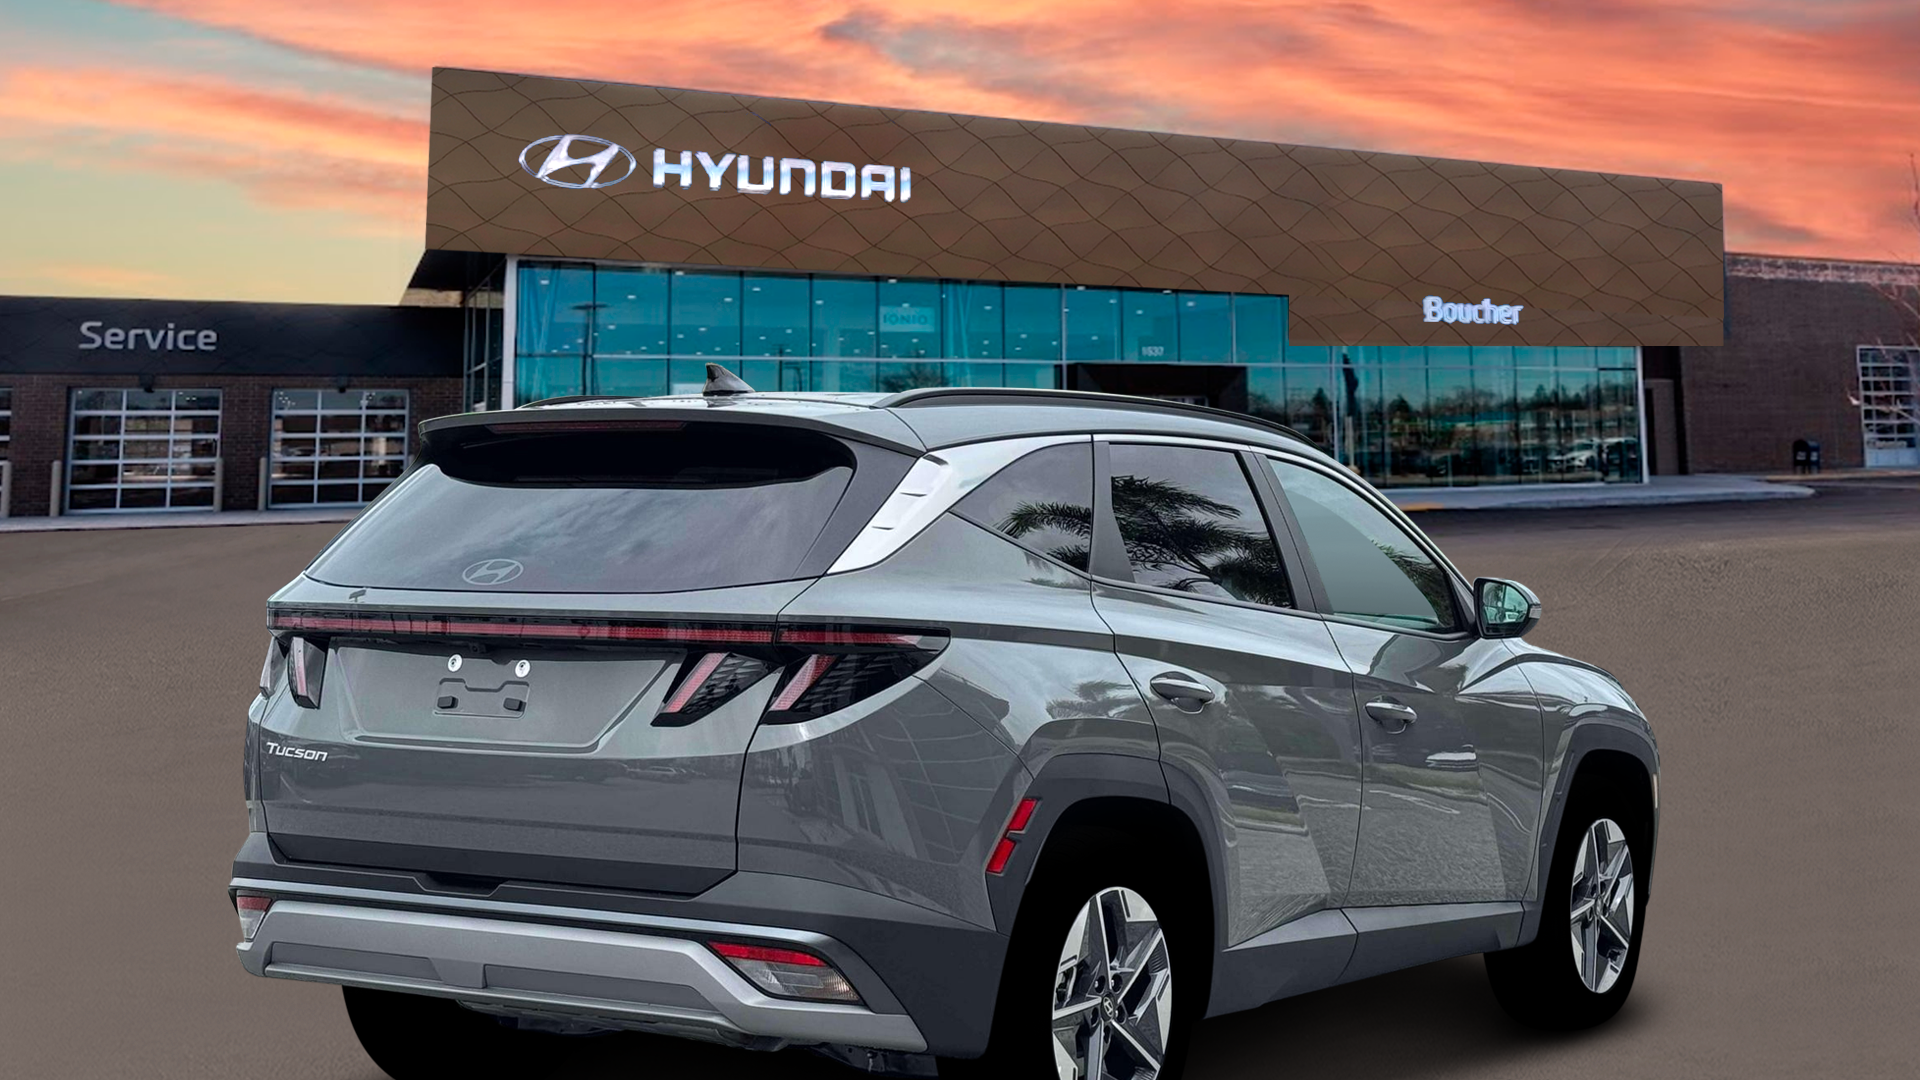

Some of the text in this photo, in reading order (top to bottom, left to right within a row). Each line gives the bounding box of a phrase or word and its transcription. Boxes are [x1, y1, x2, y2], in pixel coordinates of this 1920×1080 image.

[652, 148, 911, 202] HYUNDAI
[1422, 295, 1524, 325] Boucher
[78, 321, 217, 350] Service
